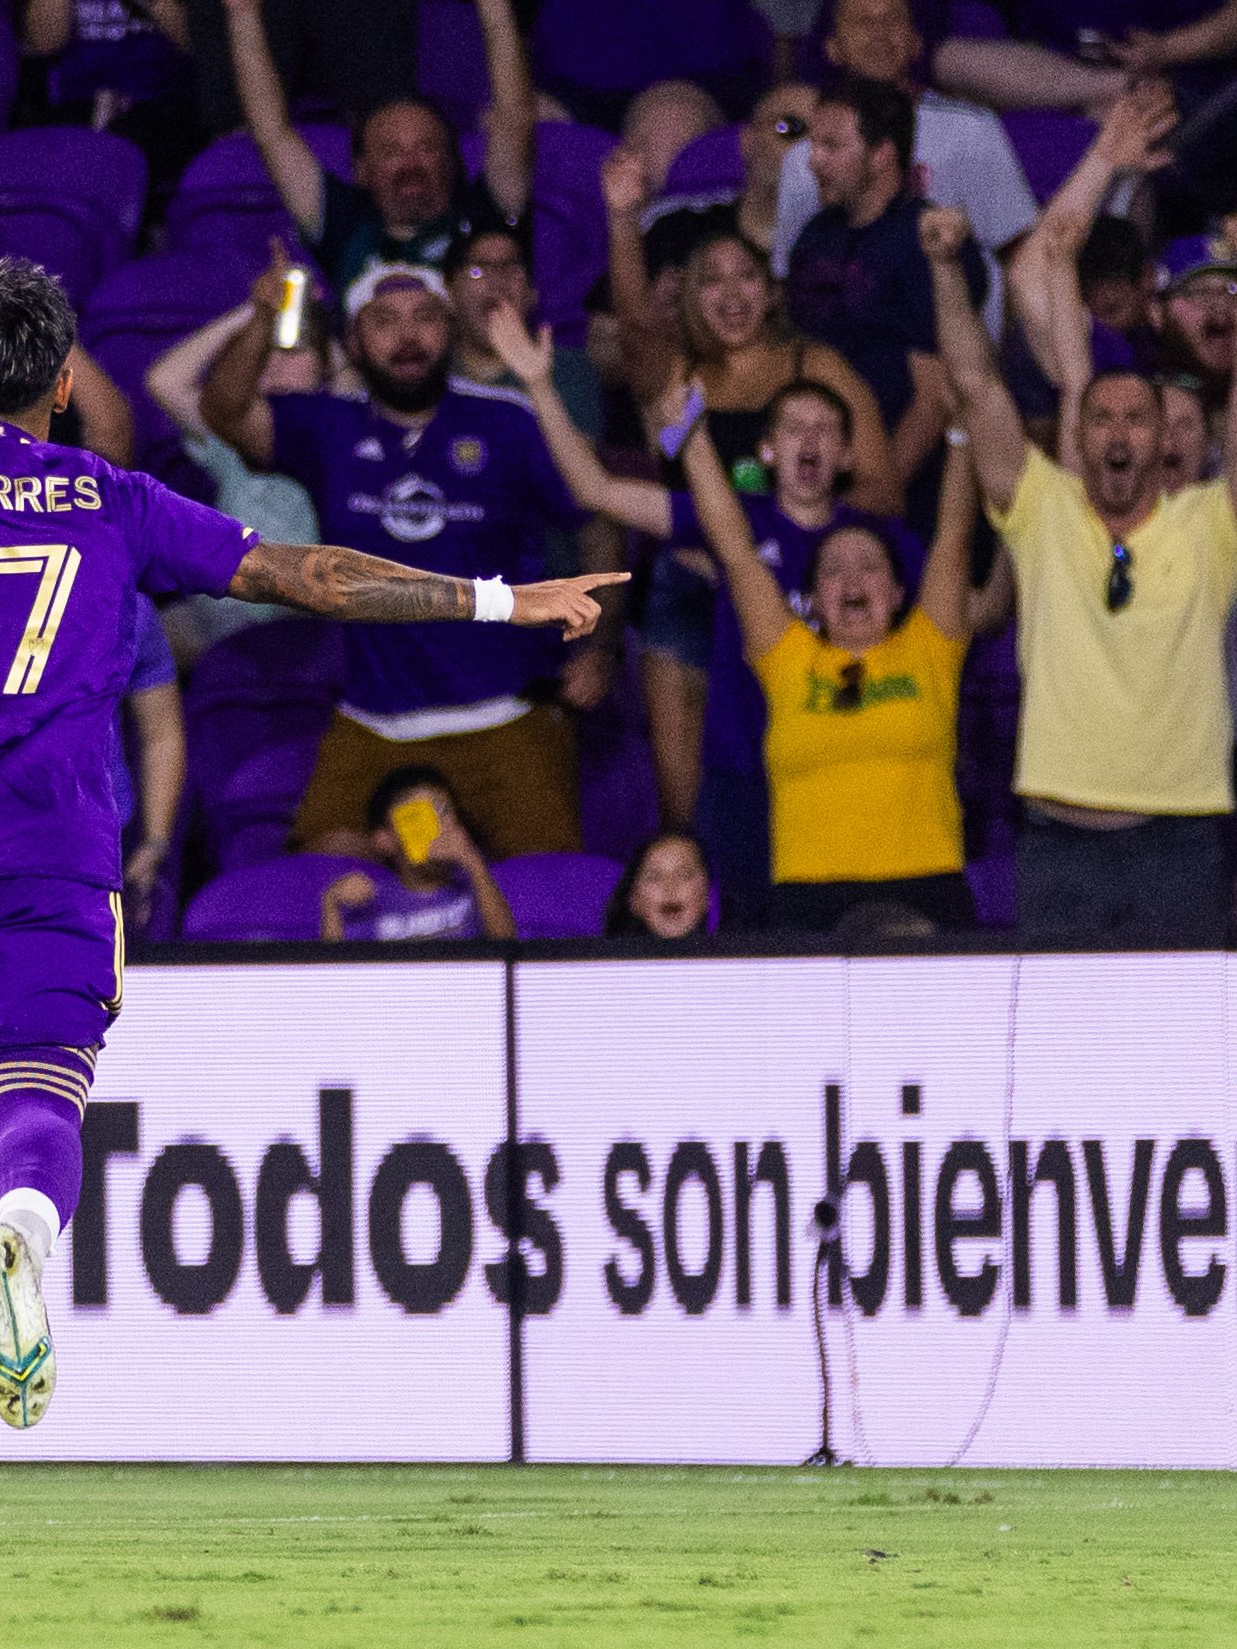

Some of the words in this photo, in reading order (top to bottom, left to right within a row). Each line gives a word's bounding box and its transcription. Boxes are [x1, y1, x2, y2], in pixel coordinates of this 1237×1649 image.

[72, 1088, 564, 1316] Todos
[603, 1140, 792, 1316] son
[824, 1084, 1228, 1317] bienve
